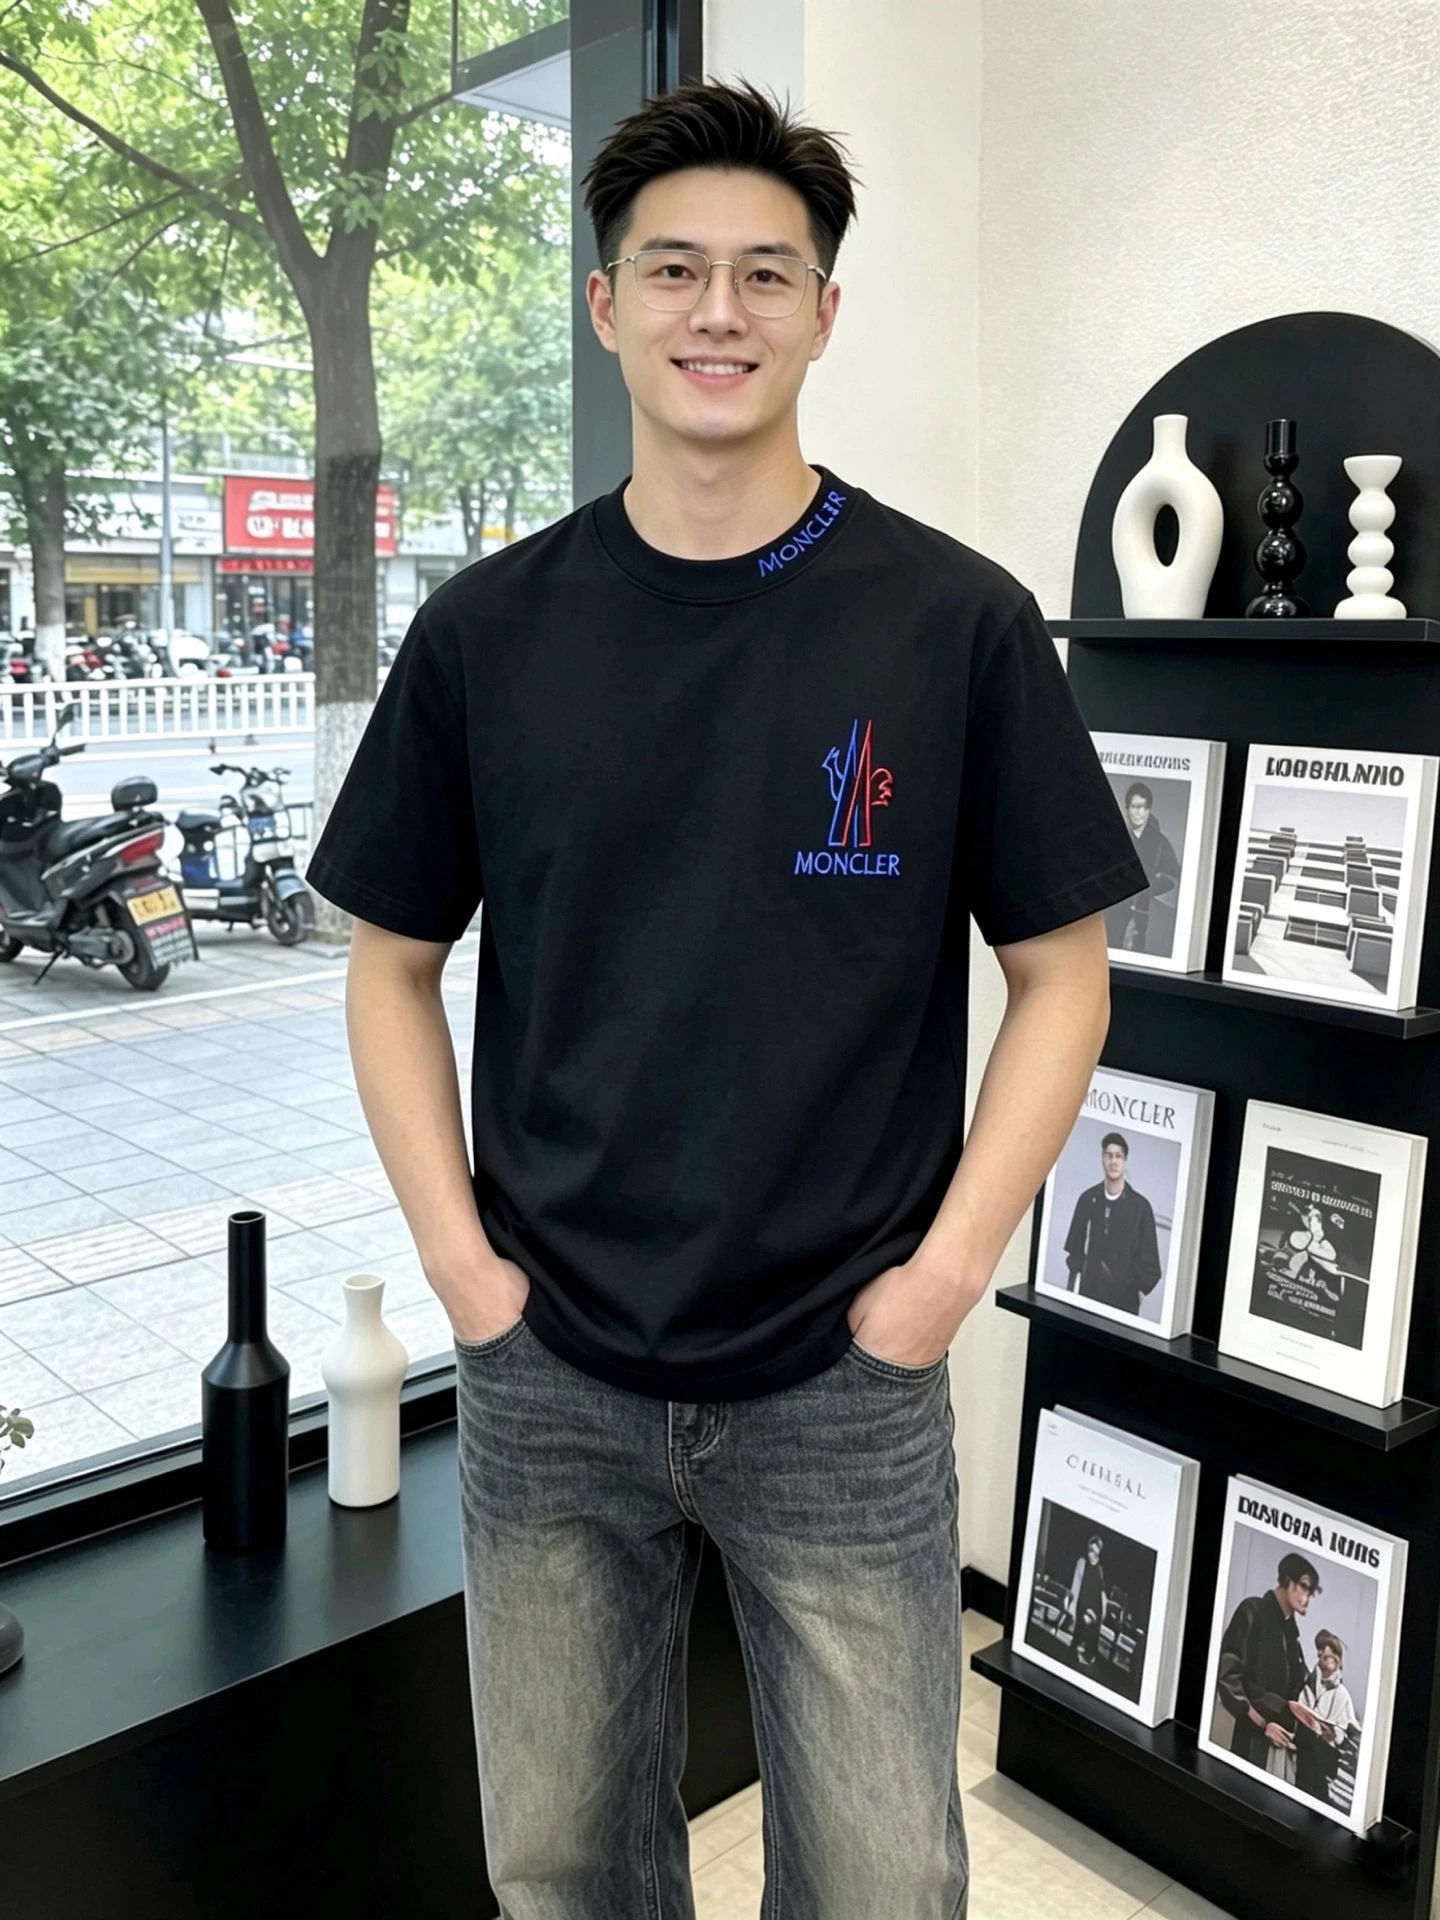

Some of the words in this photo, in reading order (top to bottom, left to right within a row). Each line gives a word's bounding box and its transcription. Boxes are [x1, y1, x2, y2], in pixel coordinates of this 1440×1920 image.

[758, 490, 847, 578] MONCLER
[793, 850, 901, 876] MONCLER
[1086, 1088, 1175, 1130] MONCLER
